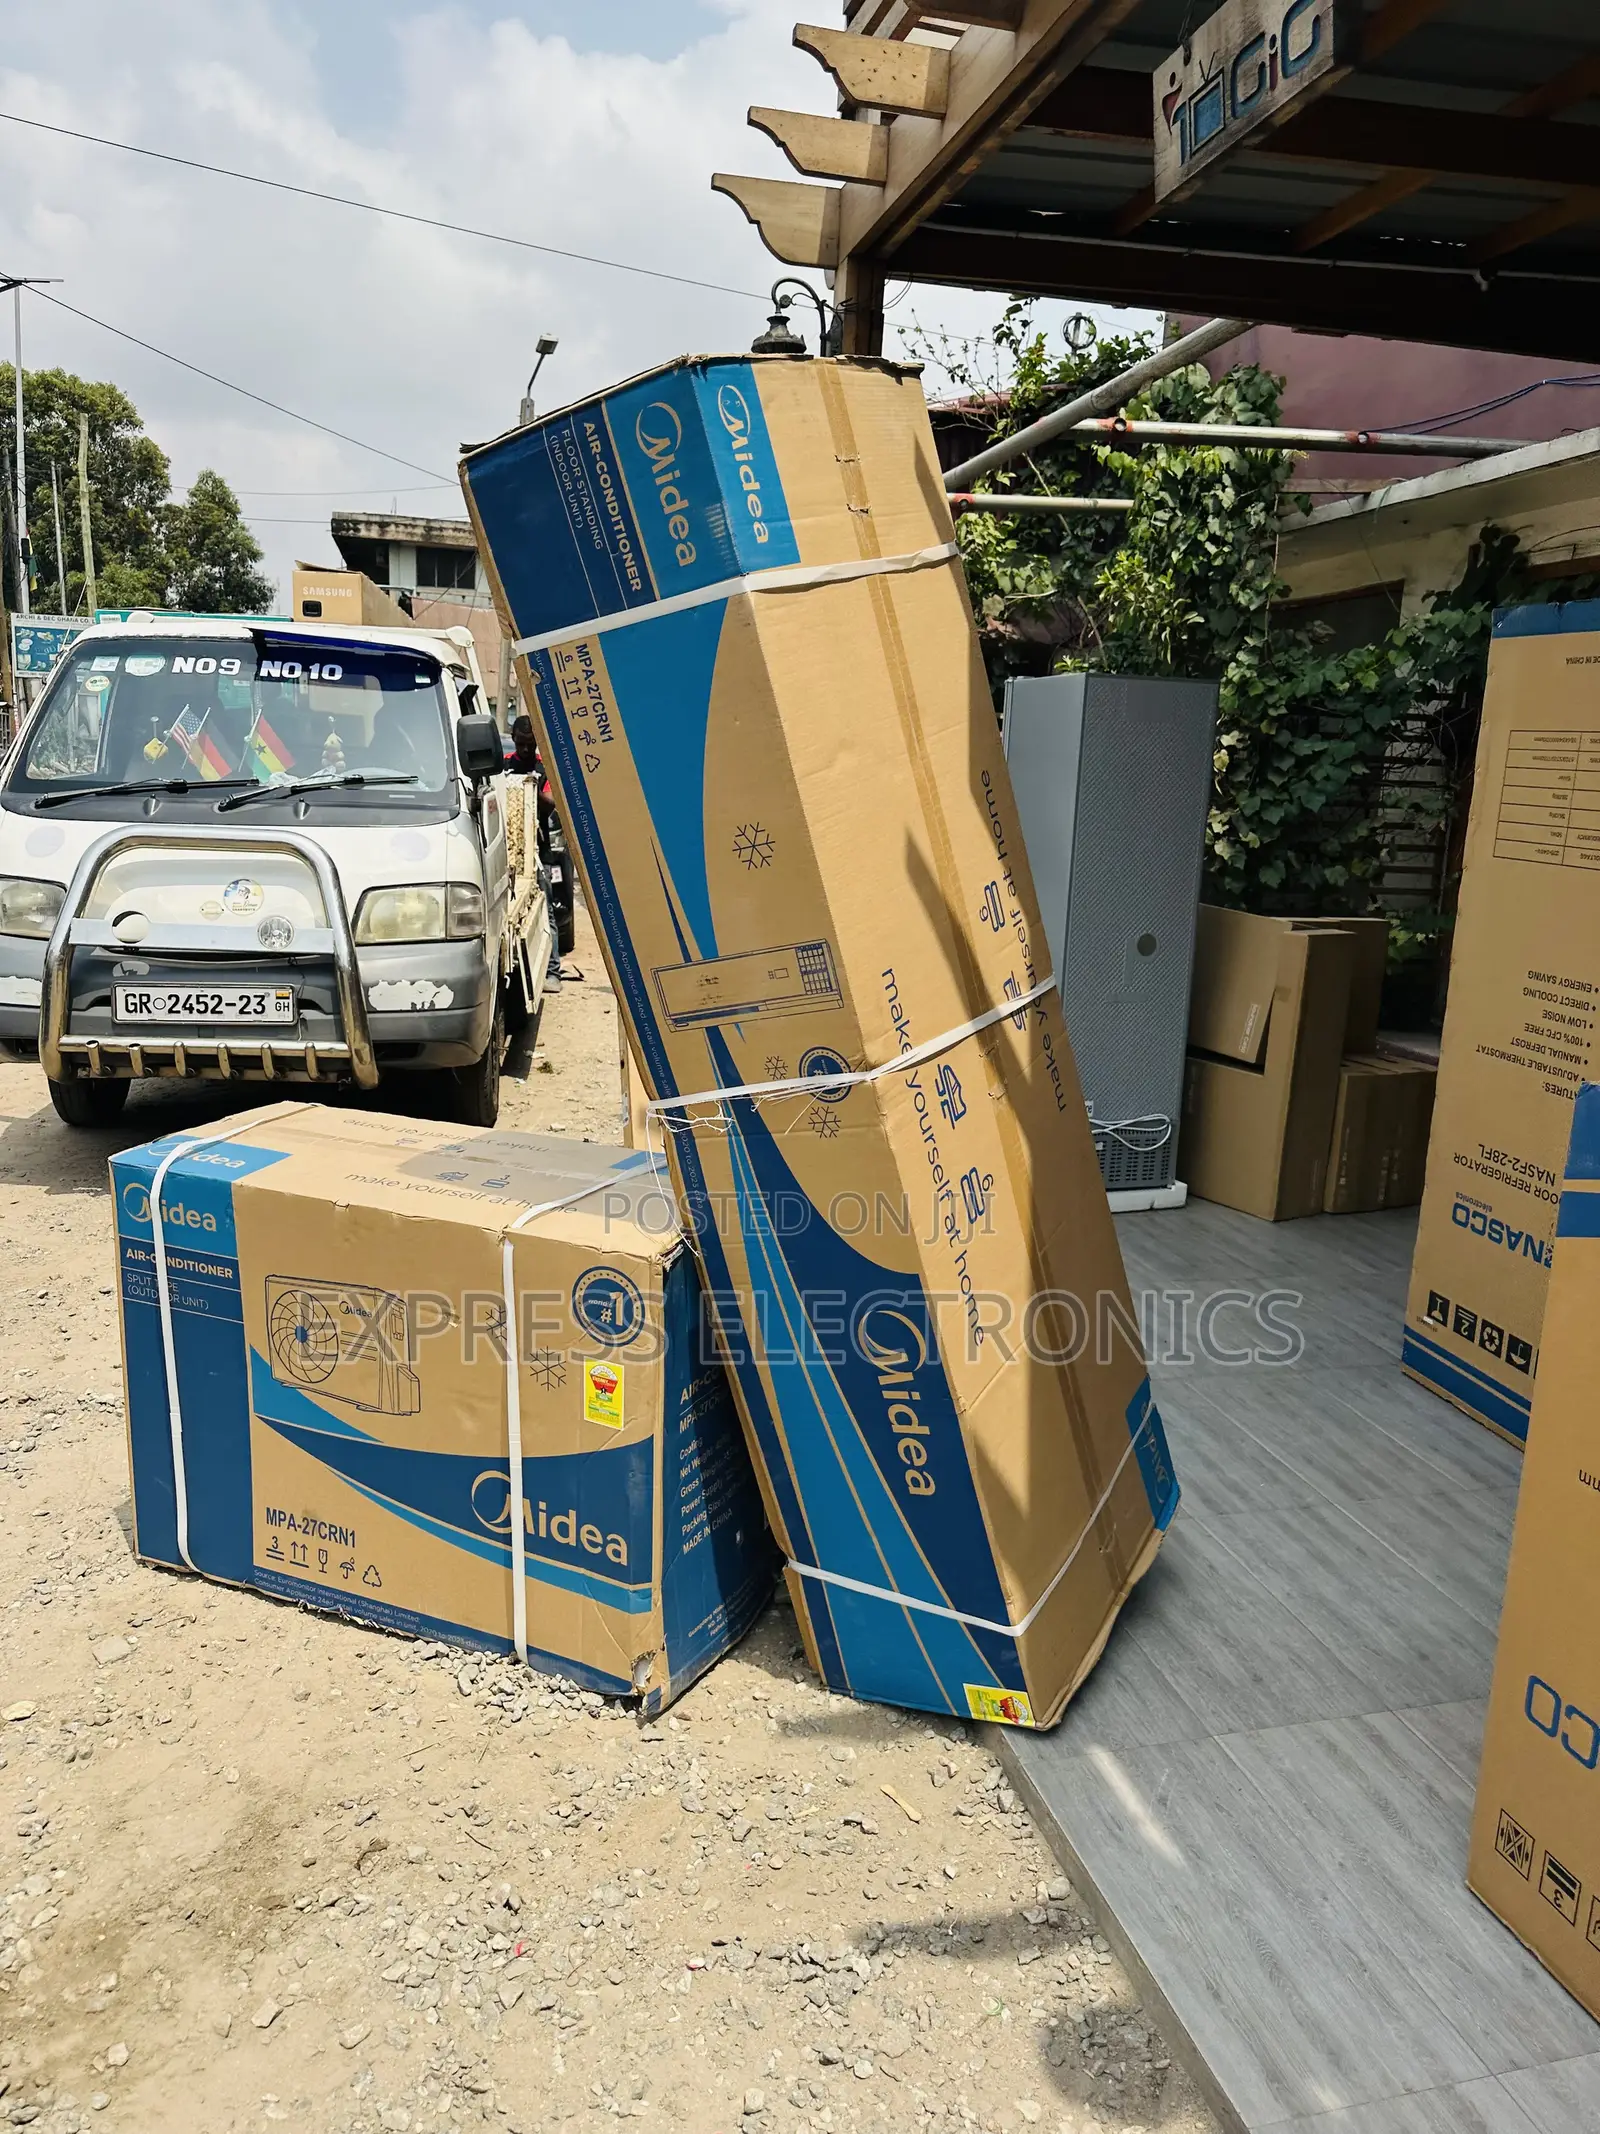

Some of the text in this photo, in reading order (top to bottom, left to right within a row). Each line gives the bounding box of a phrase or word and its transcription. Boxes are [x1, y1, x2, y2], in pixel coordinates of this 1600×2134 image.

[717, 385, 768, 544] Midea
[550, 435, 584, 529] (INDOOR UNIT)
[562, 429, 603, 550] FLOOR STANDING
[636, 402, 696, 567] Midea
[584, 422, 642, 592] AIR-CONDITIONER
[302, 585, 353, 598] SAMSUNG
[259, 659, 343, 682] NO 10
[564, 654, 574, 663] 6
[575, 643, 614, 743] MPA-27CRN1
[534, 651, 548, 681] ource:
[543, 683, 565, 745] Euromonitor
[562, 747, 584, 808] International
[578, 809, 599, 862] (Shanghai)
[606, 902, 624, 949] Consumer
[620, 951, 638, 995] Appliance
[981, 769, 1006, 861] home
[1002, 865, 1016, 897] at
[1527, 970, 1592, 993] ENERGY SAVING
[124, 993, 266, 1015] GR 2452-23
[275, 1001, 290, 1012] GH
[1522, 987, 1590, 1011] DIRECT COOLING
[1524, 1022, 1583, 1047] 100% CFC FREE
[1542, 1009, 1587, 1029] LOW NOISE
[1475, 1043, 1580, 1082] ADJUSTABLE THERMOSTAT
[1510, 1036, 1582, 1065] MANUAL DEFROST
[1042, 1034, 1067, 1112] make
[1541, 1081, 1577, 1100] TURES:
[148, 1142, 246, 1169] idea
[881, 968, 985, 1347] make yourself at home
[1478, 1143, 1556, 1187] NASF2-28FL
[344, 1171, 400, 1188] make
[405, 1180, 489, 1202] yourself
[488, 1195, 516, 1207] at
[1453, 1152, 1561, 1205] OOR REFRIGERATOR
[1455, 1191, 1493, 1214] electronics
[126, 1248, 233, 1279] AIR-CNDITIONER
[127, 1273, 152, 1286] SPLIT
[182, 1296, 209, 1311] UNIT)
[339, 1301, 373, 1319] Midea
[857, 1309, 936, 1498] Midea
[680, 1477, 699, 1498] Gross
[471, 1470, 629, 1567] Midea
[681, 1495, 701, 1517] Power
[266, 1506, 357, 1549] MPA-27CRN1
[682, 1509, 707, 1536] Packing
[682, 1507, 733, 1555] MADE IN CHINA
[271, 1535, 279, 1550] 3
[277, 1575, 317, 1594] Euromonitor
[317, 1586, 358, 1605] International
[358, 1598, 394, 1616] (Shanghai)
